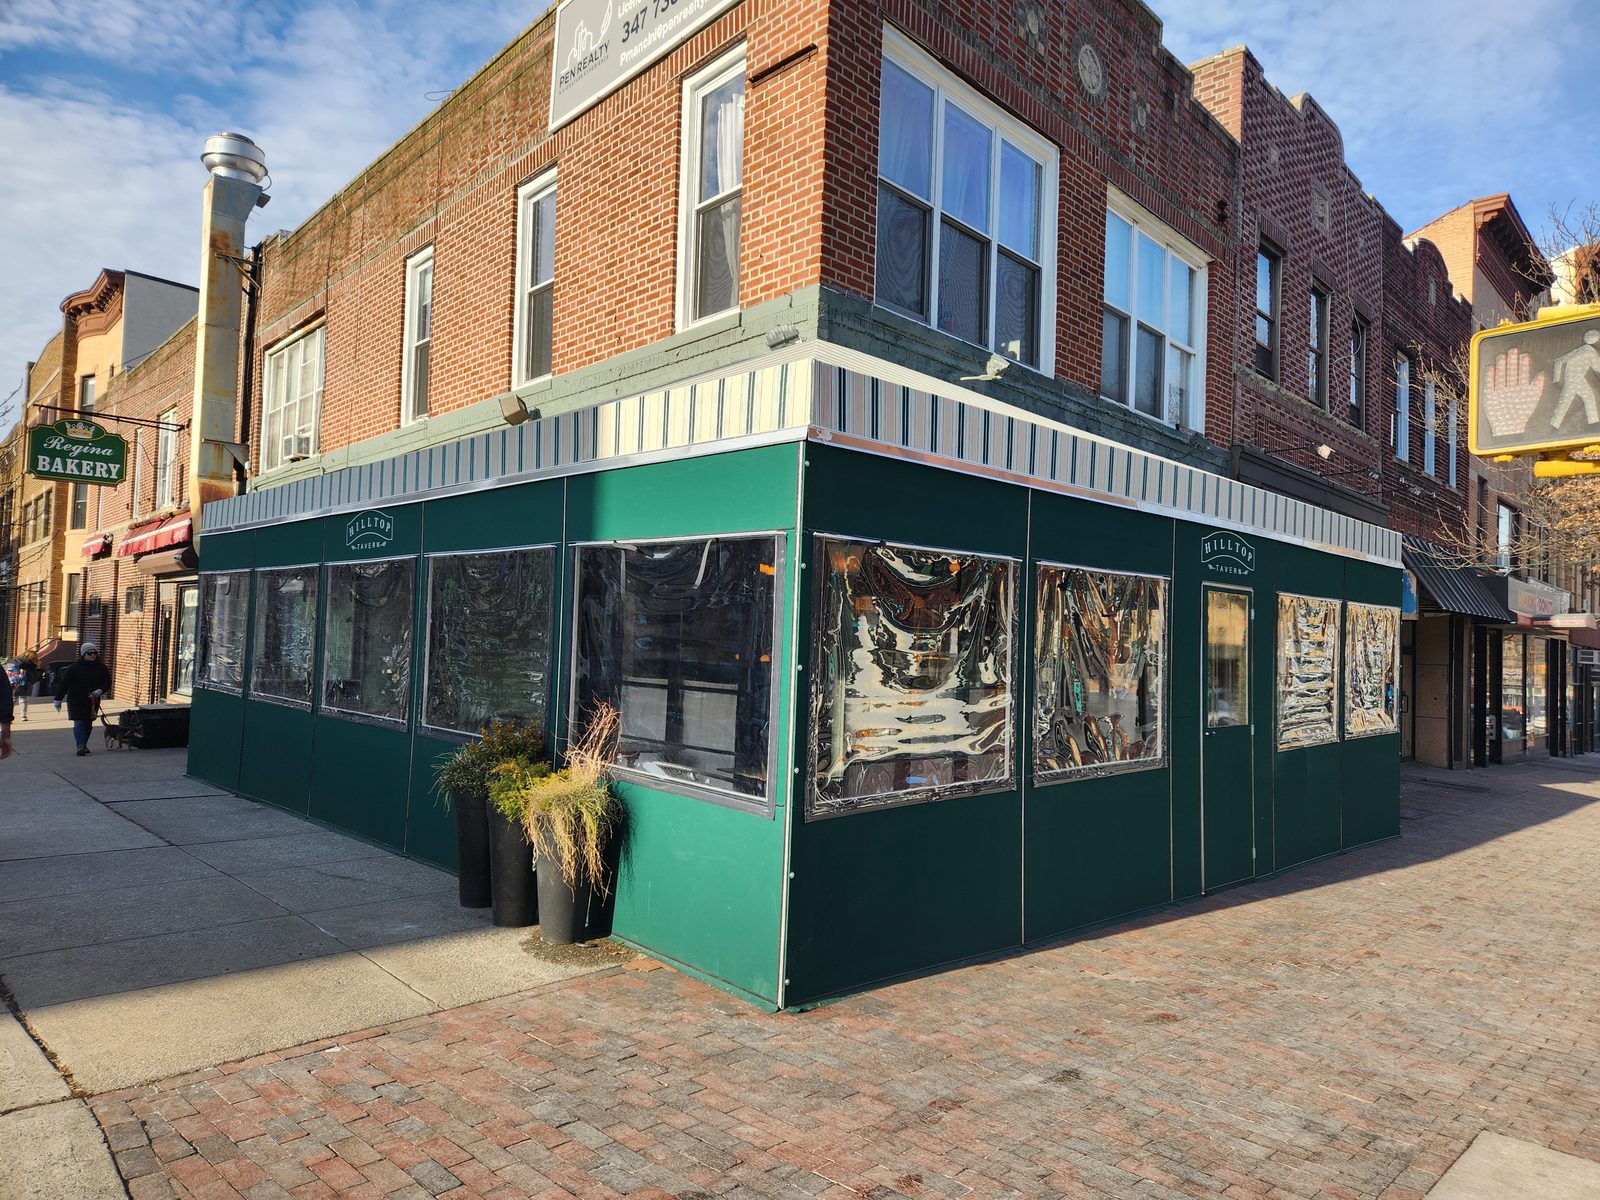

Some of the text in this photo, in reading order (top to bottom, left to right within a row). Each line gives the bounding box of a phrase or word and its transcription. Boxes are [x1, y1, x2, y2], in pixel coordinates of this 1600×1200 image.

[621, 0, 678, 43] 347 73
[559, 40, 611, 88] PEN REALTY
[43, 435, 114, 457] Regina
[36, 455, 120, 479] BAKERY
[348, 517, 391, 537] HILLTOP
[357, 541, 381, 550] TAVERN
[1204, 538, 1253, 562] HILLTOP
[1215, 564, 1242, 575] TAVERN
